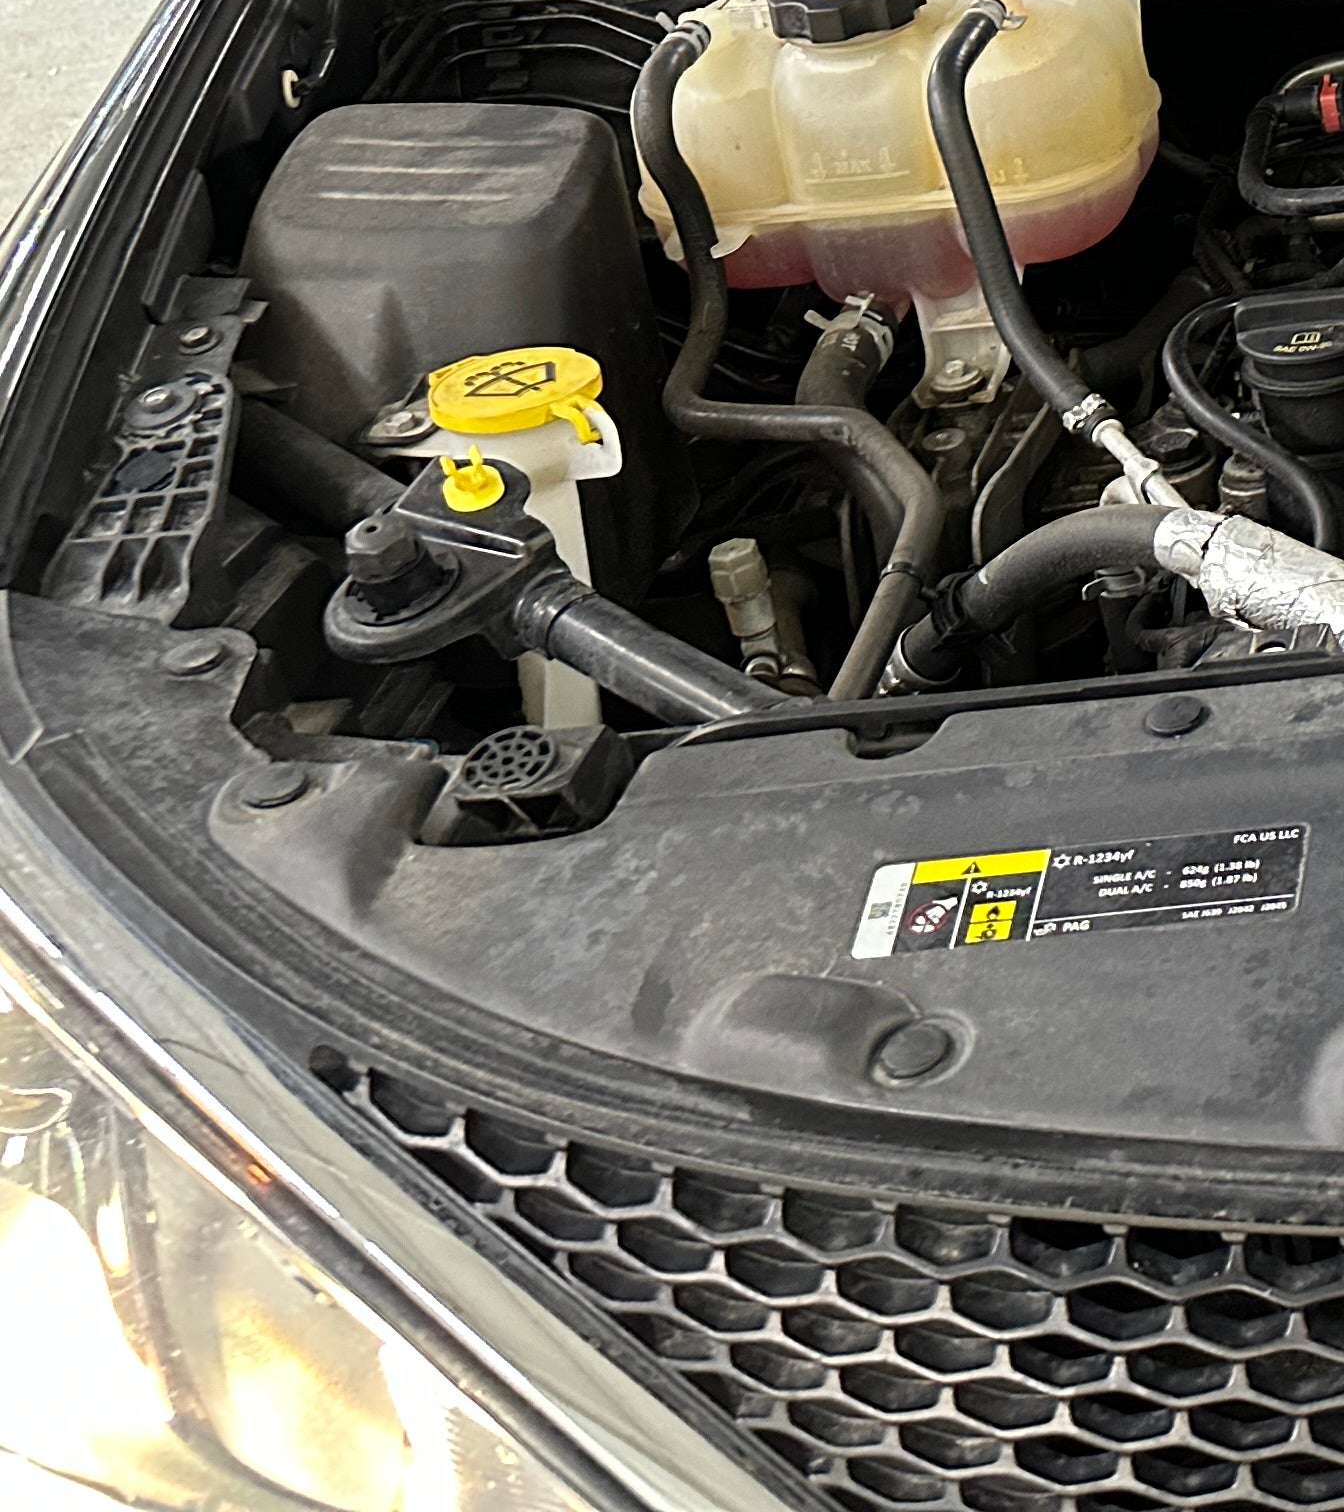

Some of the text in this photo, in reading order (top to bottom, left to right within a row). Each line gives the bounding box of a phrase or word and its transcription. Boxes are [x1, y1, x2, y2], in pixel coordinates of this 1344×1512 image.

[1233, 828, 1300, 844] FCA US LLC
[1073, 849, 1135, 866] R-1234yf
[1092, 872, 1133, 885] SINGLE
[1134, 869, 1157, 881] A/C
[1098, 885, 1130, 898] DUAL
[1131, 883, 1154, 894] A/C
[1062, 919, 1091, 933] PAG
